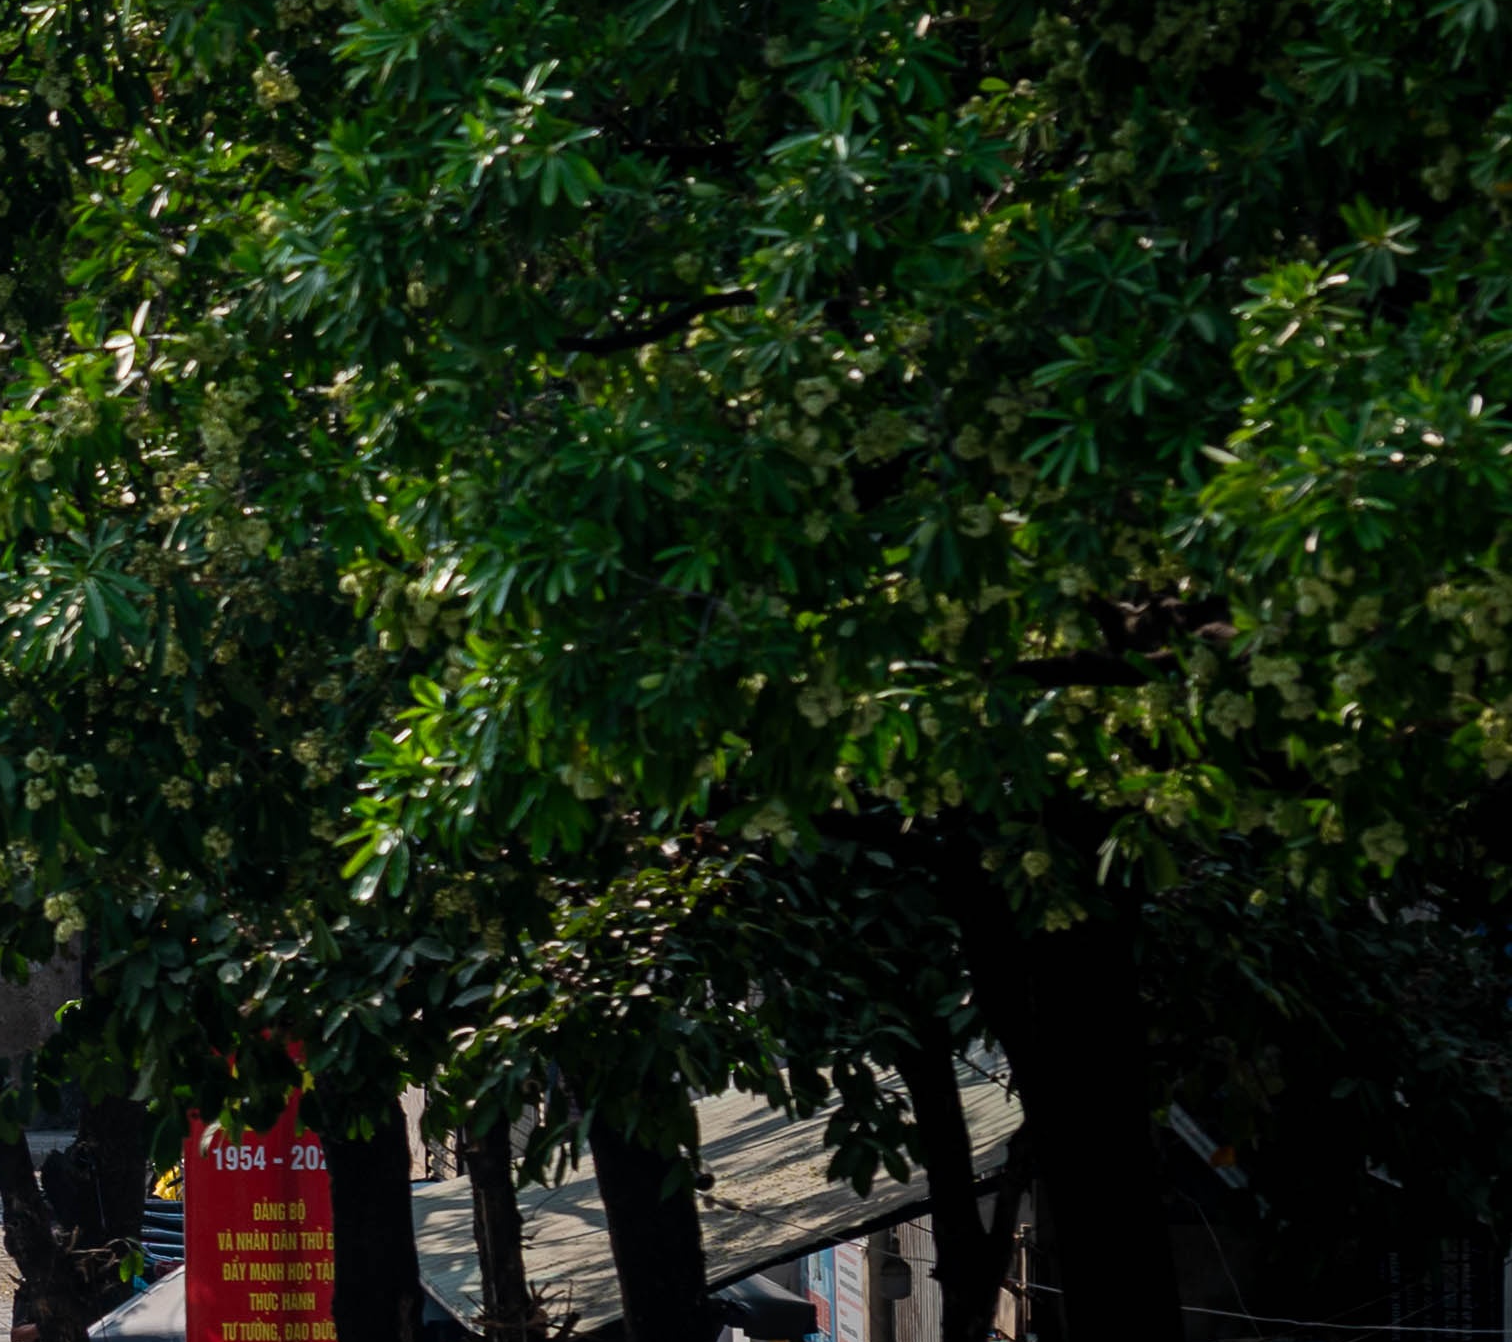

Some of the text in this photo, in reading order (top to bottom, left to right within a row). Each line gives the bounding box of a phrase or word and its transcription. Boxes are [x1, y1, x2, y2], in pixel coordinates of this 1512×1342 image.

[213, 1145, 266, 1170] 1954
[253, 1196, 306, 1224] ĐẢNG BỘ
[217, 1228, 233, 1251] VÀ
[236, 1228, 269, 1251] NHÂN
[272, 1229, 297, 1251] DÂN
[301, 1226, 324, 1250] THỦ
[223, 1254, 335, 1285] ĐẨY MẠNH HỌC TẬ
[249, 1289, 316, 1315] THỰC HÀNH
[222, 1322, 238, 1342] TƯ
